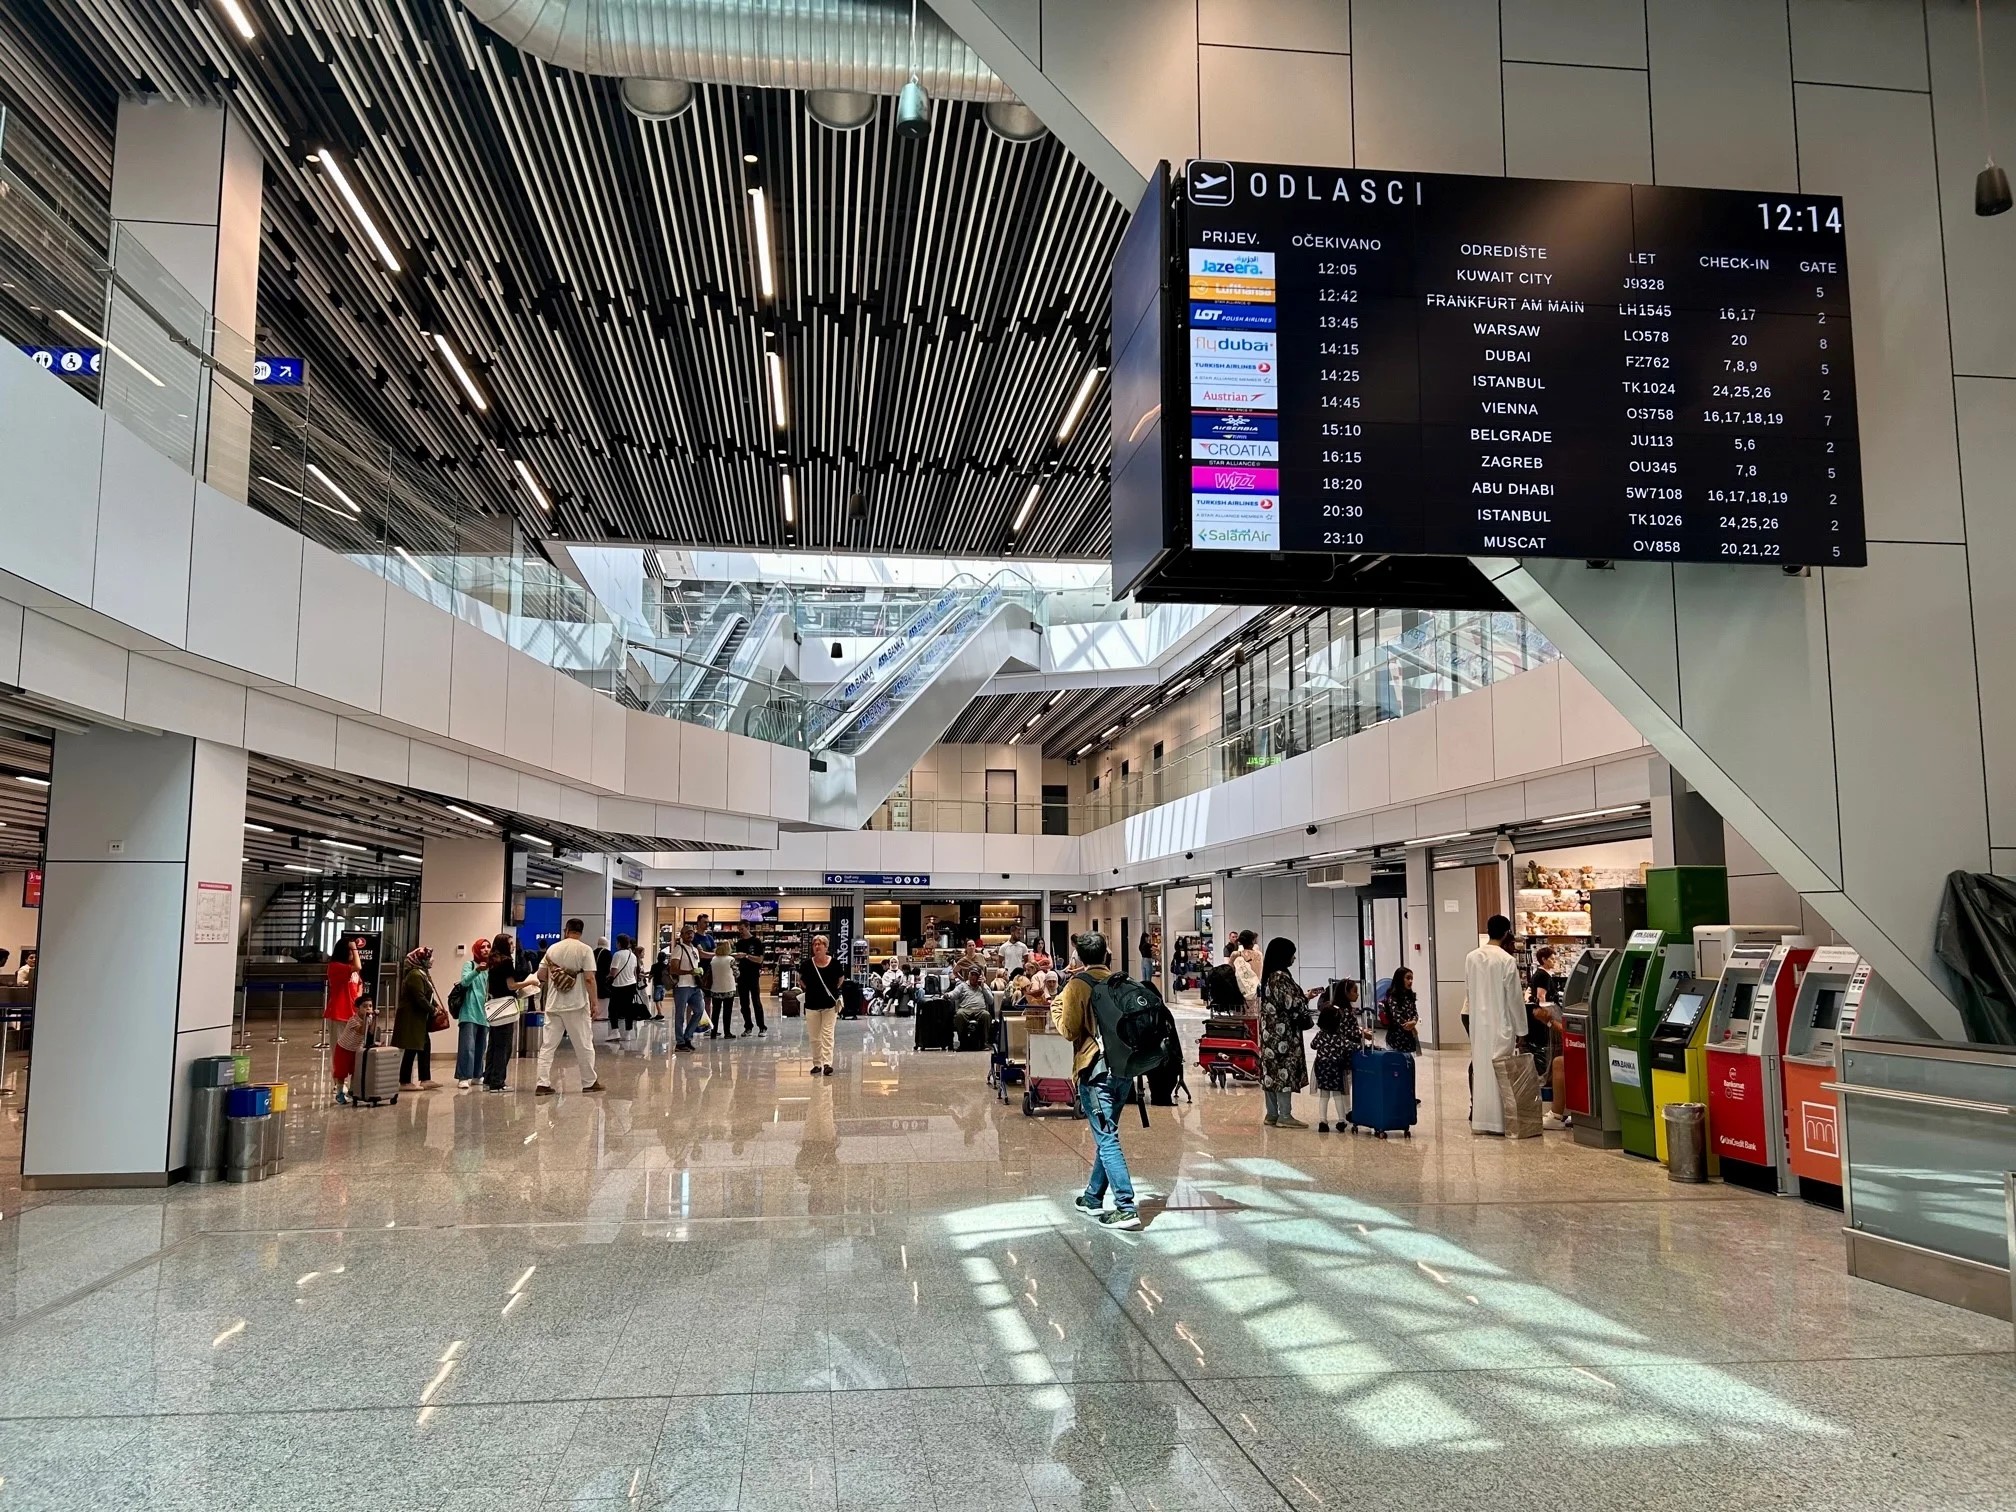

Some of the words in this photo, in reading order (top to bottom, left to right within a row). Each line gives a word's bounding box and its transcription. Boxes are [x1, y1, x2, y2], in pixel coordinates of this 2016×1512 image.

[1250, 172, 1422, 206] ODLASCI
[1757, 203, 1842, 234] 12:14
[1202, 230, 1260, 245] PRIJEV.
[1291, 233, 1381, 251] OČEKIVANO
[1460, 243, 1548, 260] ODREDIŠTE
[1629, 252, 1656, 265] LET
[1318, 262, 1357, 276] 12:05
[1699, 256, 1770, 270] CHECK-IN
[1799, 261, 1837, 274] GATE
[1456, 269, 1515, 284] KUWAIT
[1518, 272, 1553, 285] CITY
[1623, 277, 1665, 291] J9328
[1215, 282, 1272, 296] Lufthansa
[1319, 288, 1358, 303] 12:42
[1816, 286, 1824, 298] 5
[1426, 293, 1517, 310] FRANKFURT
[1520, 298, 1543, 312] AM
[1547, 299, 1585, 313] MAIN
[1619, 303, 1672, 317] LH1545
[1194, 309, 1223, 320] LOT
[1719, 307, 1756, 322] 16,17
[1818, 312, 1826, 324] 2
[1319, 316, 1359, 329] 13:45
[1473, 322, 1541, 337] WARSAW
[1624, 329, 1669, 343] LO578
[1731, 334, 1748, 346] 20
[1320, 342, 1359, 356] 14:15
[1819, 338, 1828, 350] 8
[1485, 349, 1531, 363] DUBAI
[1625, 355, 1670, 369] FZ762
[1723, 359, 1758, 373] 7,8,9
[1821, 364, 1829, 375] 5
[1320, 369, 1360, 382] 14:25
[1473, 375, 1546, 390] ISTANBUL
[1622, 381, 1676, 395] TK1024
[1712, 385, 1772, 399] 24,25,26
[1823, 389, 1831, 401] 2
[1203, 390, 1248, 402] Austrian
[1321, 395, 1361, 409] 14:45
[1481, 401, 1539, 415] VIENNA
[1626, 407, 1674, 421] OS758
[1703, 410, 1784, 426] 16,17,18,19
[1824, 415, 1832, 426] 7
[1322, 423, 1362, 437] 15:10
[1470, 428, 1553, 443] BELGRADE
[1630, 434, 1674, 447] JU113
[1734, 438, 1756, 452] 5,6
[1826, 442, 1834, 453] 2
[1208, 443, 1272, 457] CROATIA
[1322, 450, 1362, 464] 16:15
[1481, 455, 1543, 469] ZAGREB
[1629, 460, 1677, 474] OU345
[1735, 464, 1757, 478] 7,8
[1828, 467, 1836, 479] 5
[1323, 477, 1363, 491] 18:20
[1471, 481, 1503, 495] ABU
[1508, 483, 1554, 496] DHABI
[1626, 487, 1683, 500] 5W7108
[1707, 489, 1788, 505] 16,17,18,19
[1829, 493, 1838, 505] 2
[1323, 504, 1363, 518] 20:30
[1477, 508, 1552, 523] ISTANBUL
[1628, 513, 1683, 527] TK1026
[1719, 516, 1779, 530] 24,25,26
[1831, 520, 1839, 531] 2
[1209, 530, 1271, 542] SalamAir
[1323, 532, 1364, 545] 23:10
[1483, 535, 1547, 549] MUSCAT
[1633, 540, 1681, 553] OV858
[1721, 542, 1780, 557] 20,21,22
[1832, 546, 1841, 557] 5
[888, 638, 904, 658] BANKA
[855, 666, 874, 689] BANKA
[1669, 970, 1691, 979] ASA
